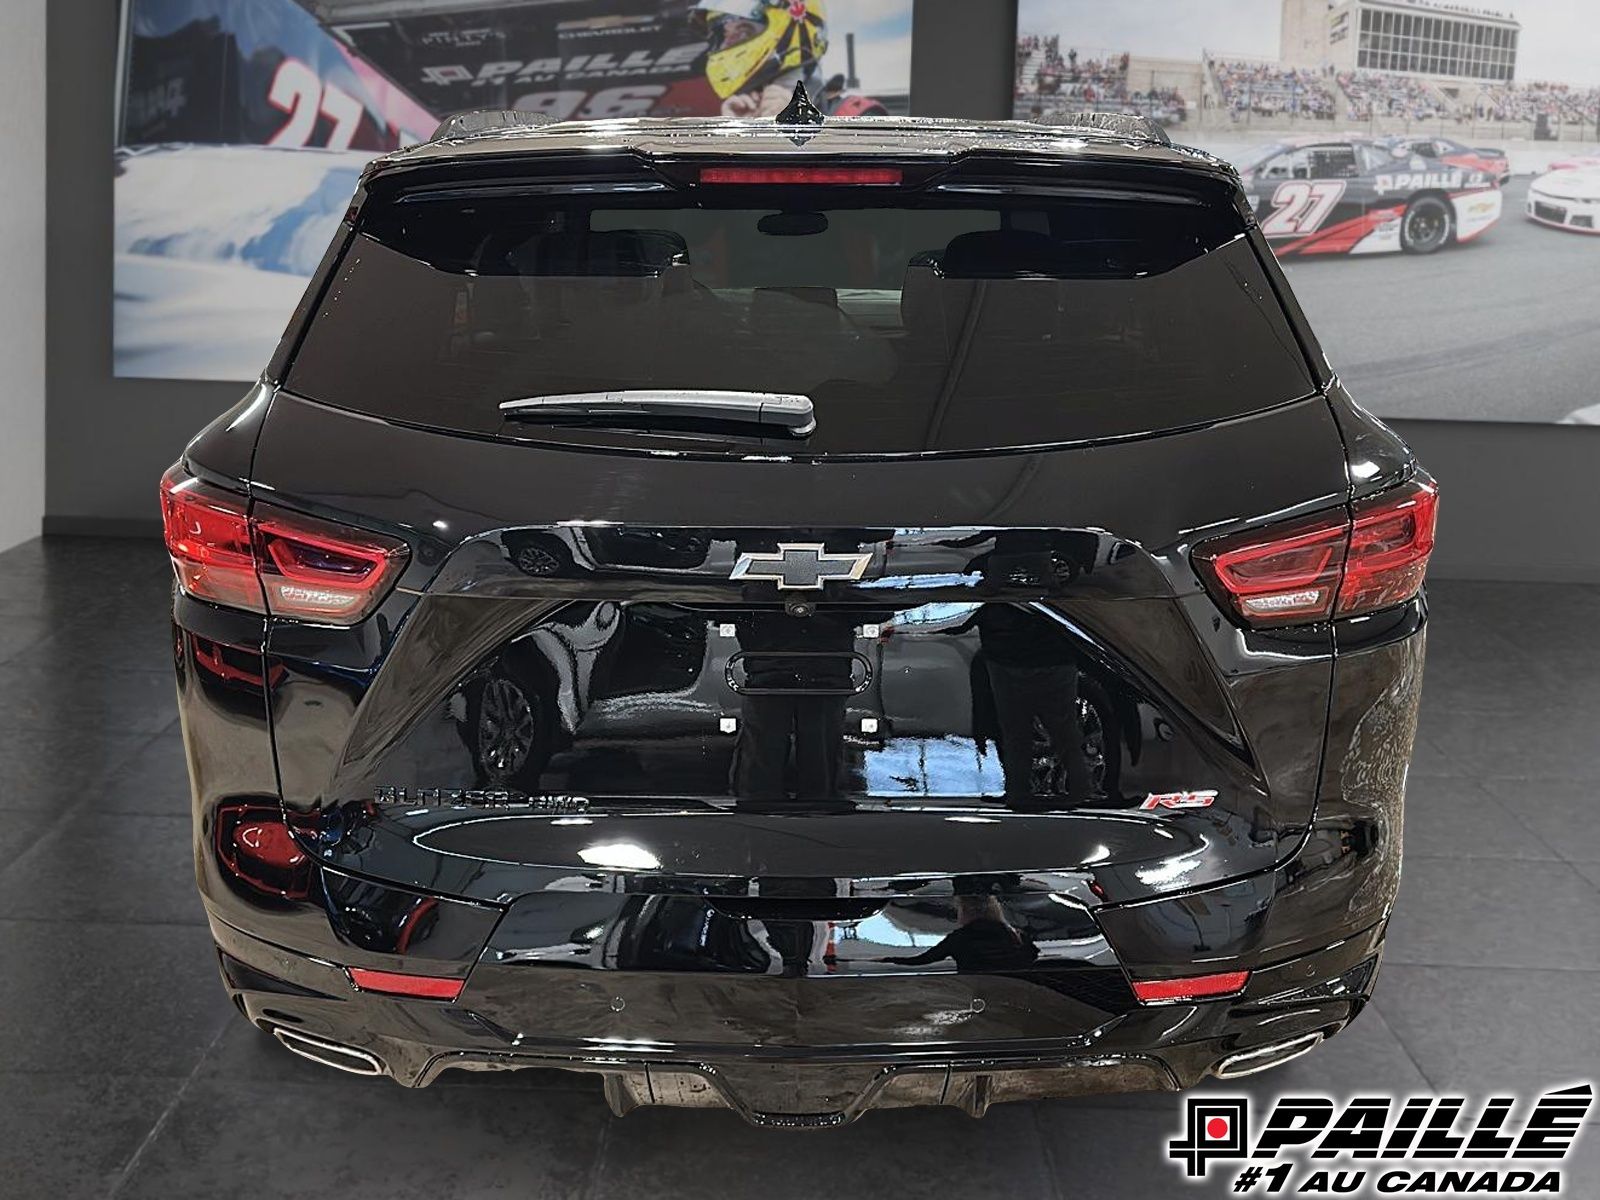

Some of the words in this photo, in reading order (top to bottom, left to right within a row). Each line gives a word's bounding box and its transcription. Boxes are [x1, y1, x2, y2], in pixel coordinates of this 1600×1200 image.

[266, 57, 365, 150] 27
[1261, 179, 1348, 239] 27
[1139, 789, 1219, 809] RS
